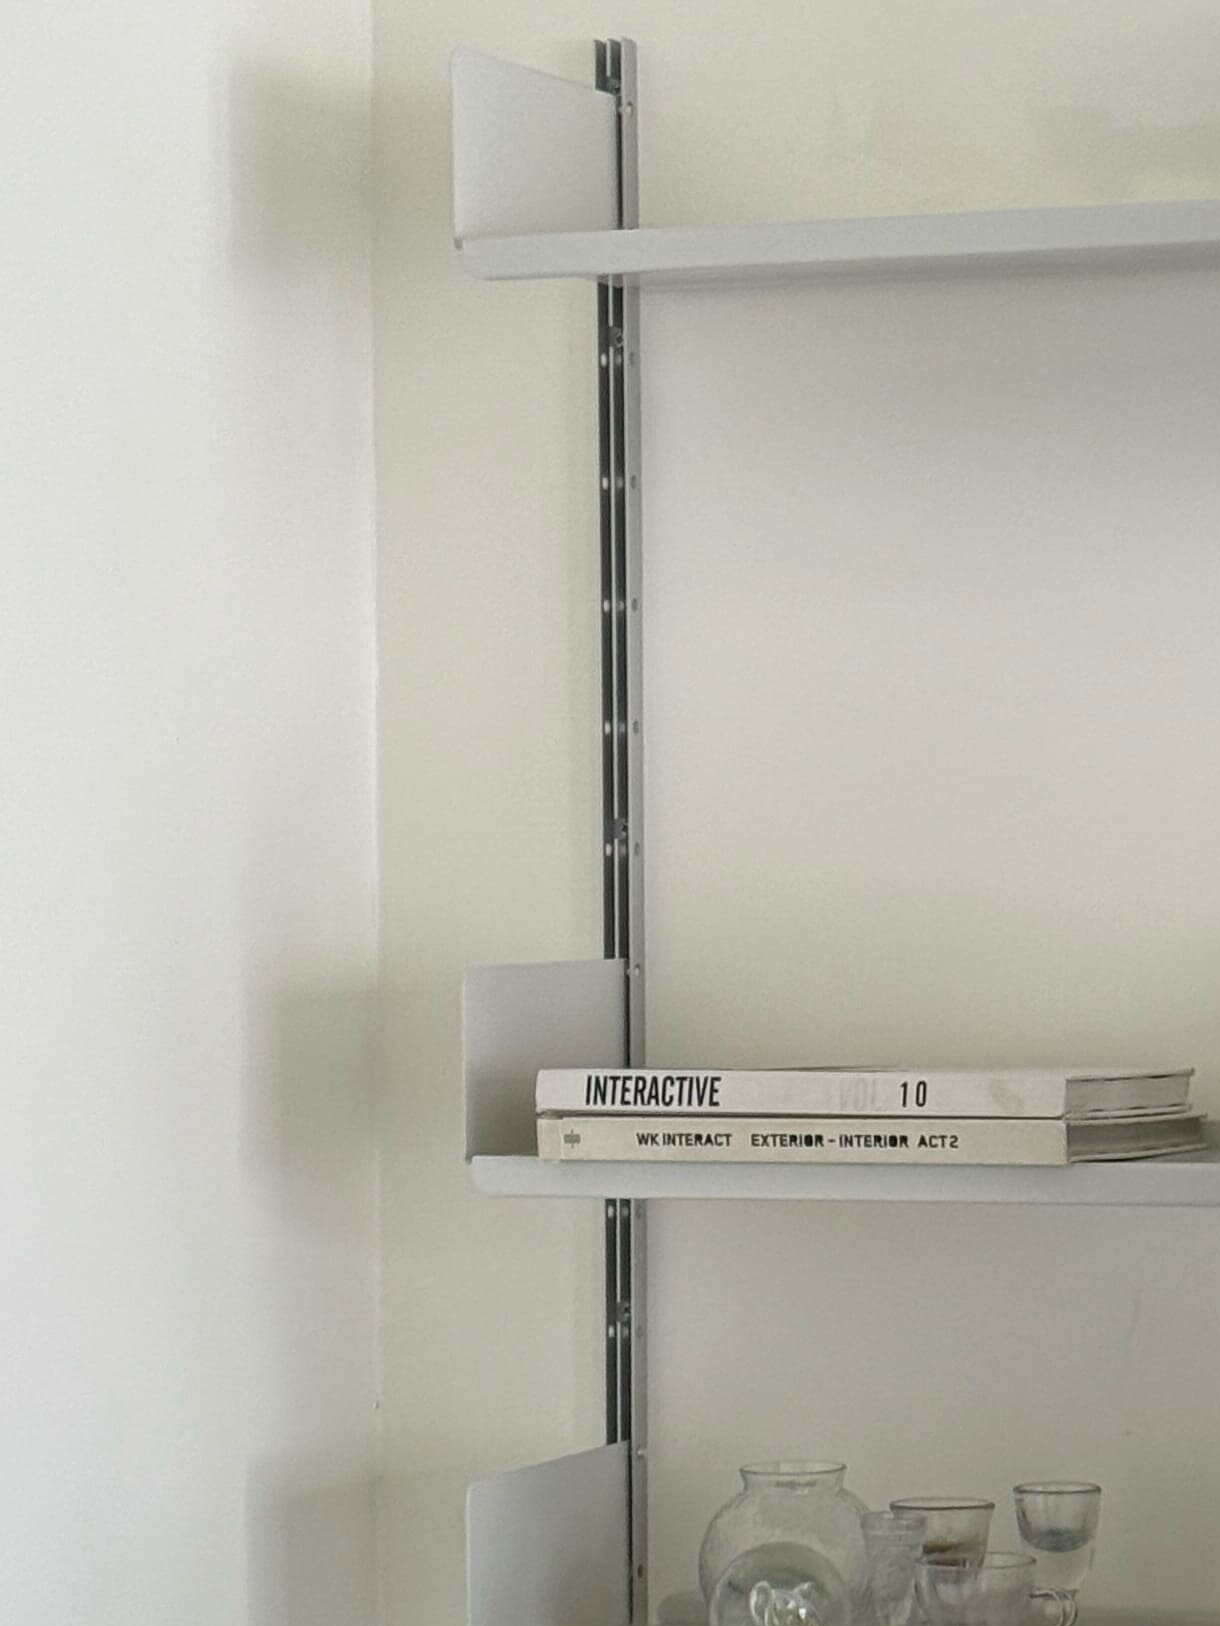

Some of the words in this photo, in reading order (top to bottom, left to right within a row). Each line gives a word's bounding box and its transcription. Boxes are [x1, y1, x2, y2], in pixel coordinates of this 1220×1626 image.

[585, 1075, 722, 1107] INTERACTIVE
[636, 1132, 661, 1147] WK
[662, 1132, 733, 1148] INTERACT
[750, 1133, 825, 1148] EXTERIOR
[839, 1133, 909, 1149] INTERIOR
